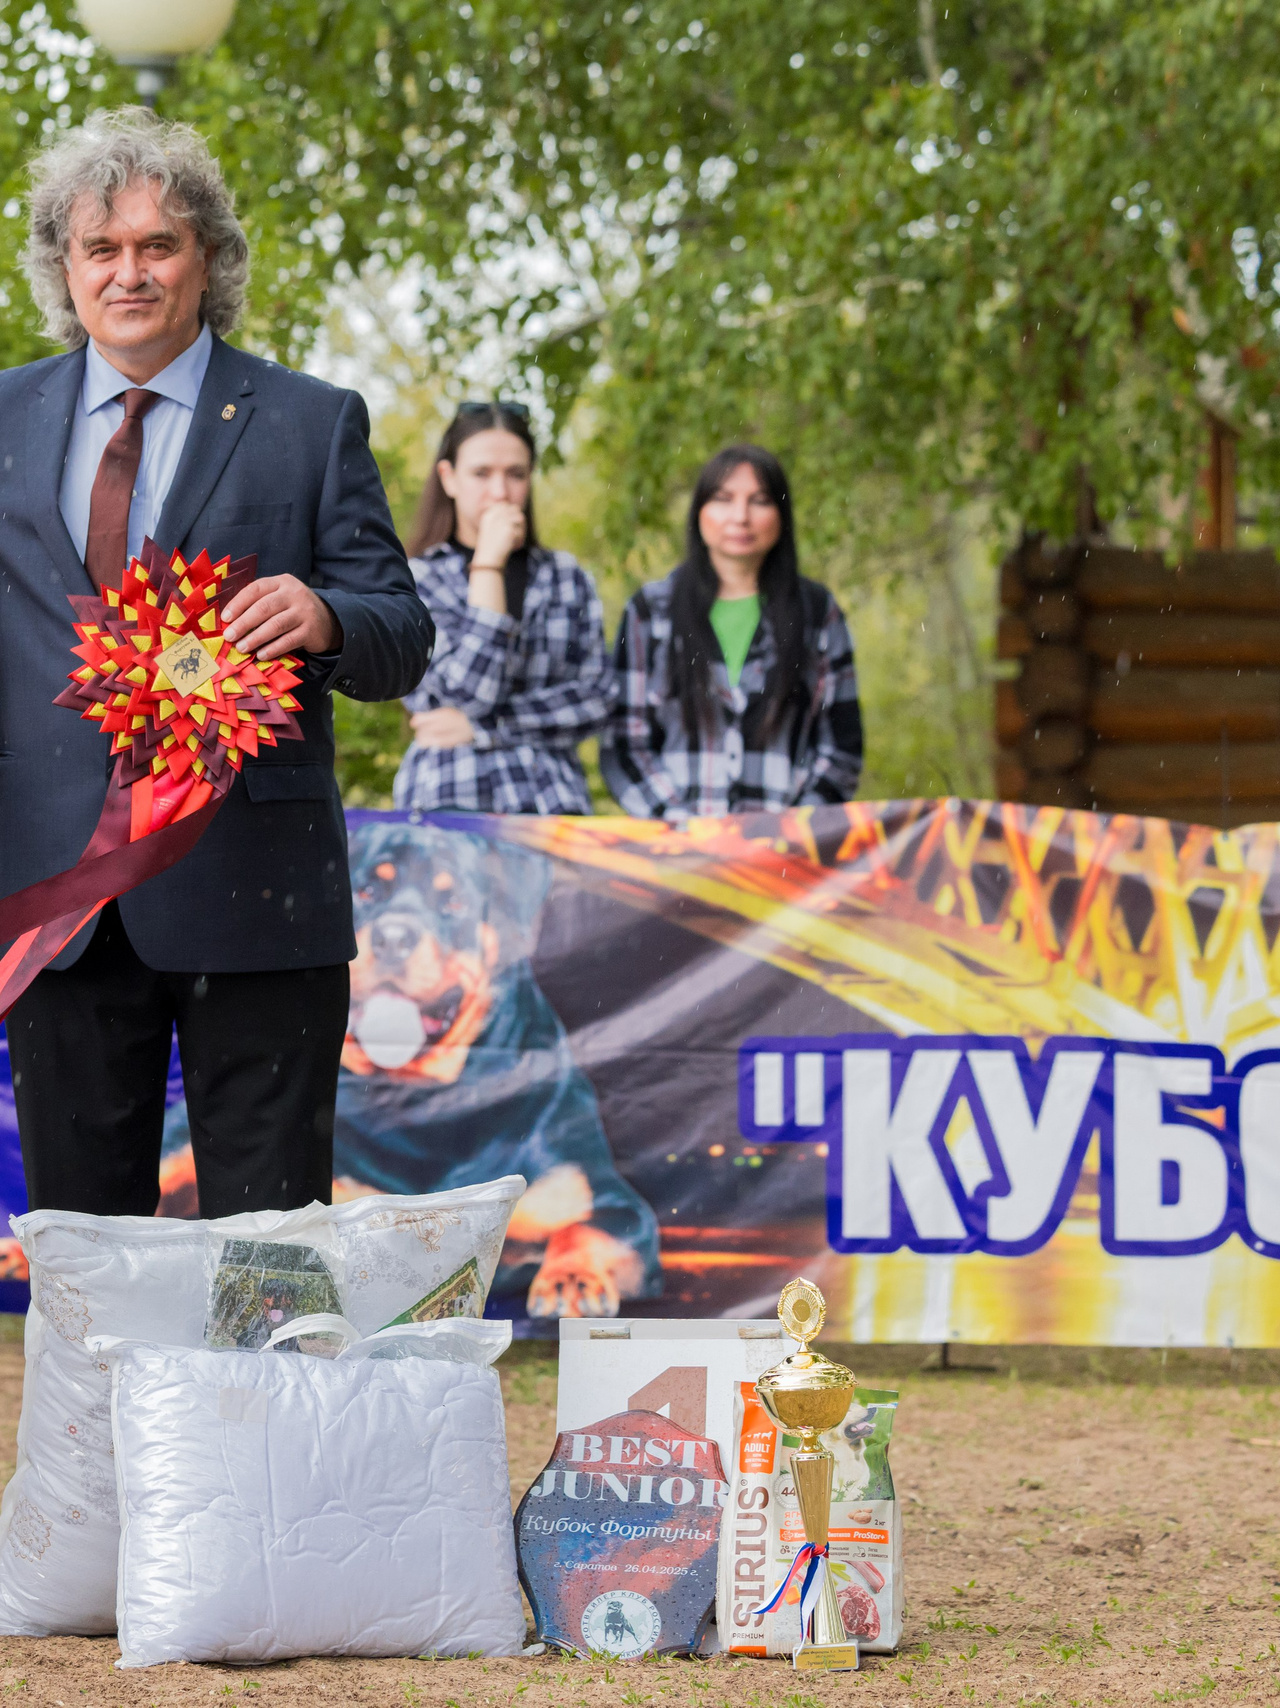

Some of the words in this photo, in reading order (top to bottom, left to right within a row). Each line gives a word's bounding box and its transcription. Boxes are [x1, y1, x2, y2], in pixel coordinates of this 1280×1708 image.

[567, 1433, 708, 1469] BEST
[744, 1443, 771, 1453] ADULT
[530, 1469, 731, 1508] JUNIOR
[524, 1515, 596, 1535] Кубок
[600, 1520, 713, 1543] Фортуны
[565, 1560, 618, 1572] Саратов
[624, 1563, 688, 1576] 26.04.2025
[733, 1486, 770, 1628] SIRIUS
[621, 1591, 648, 1604] КЛУБ
[649, 1605, 661, 1643] РОССИИ
[732, 1632, 765, 1640] PREMIUM
